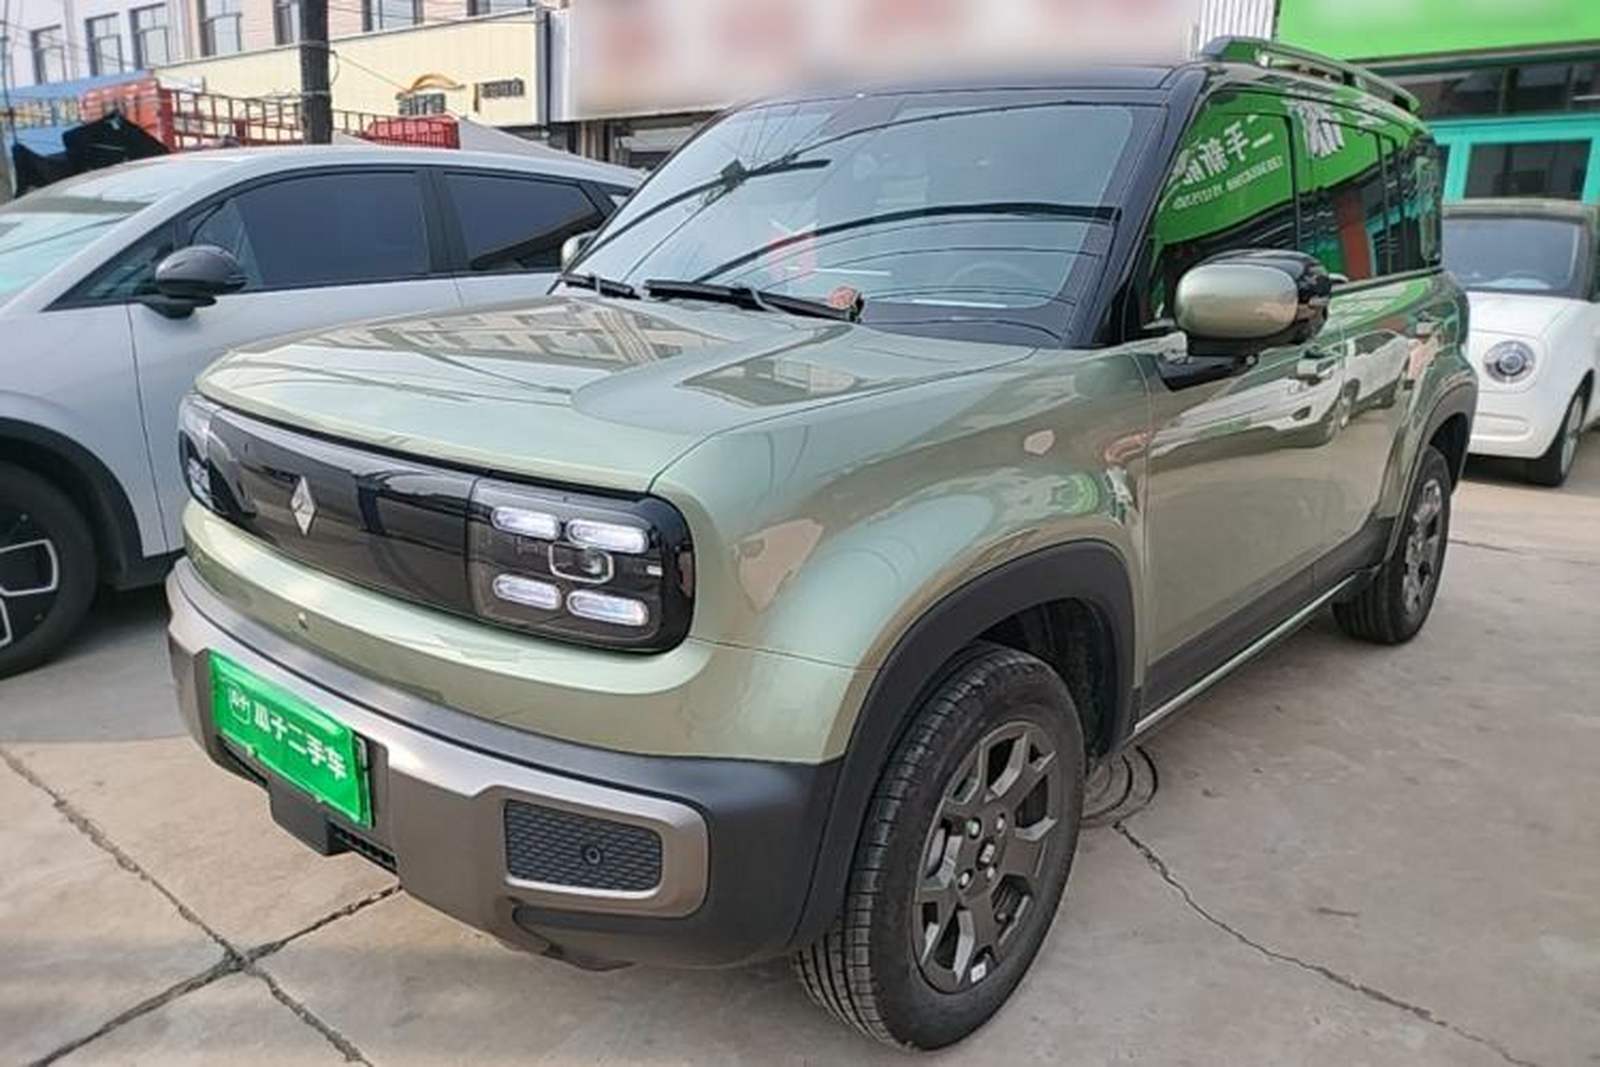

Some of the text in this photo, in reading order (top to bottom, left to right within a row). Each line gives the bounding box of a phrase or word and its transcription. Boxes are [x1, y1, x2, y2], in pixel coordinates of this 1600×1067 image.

[254, 700, 348, 781] 瓜子二手车
